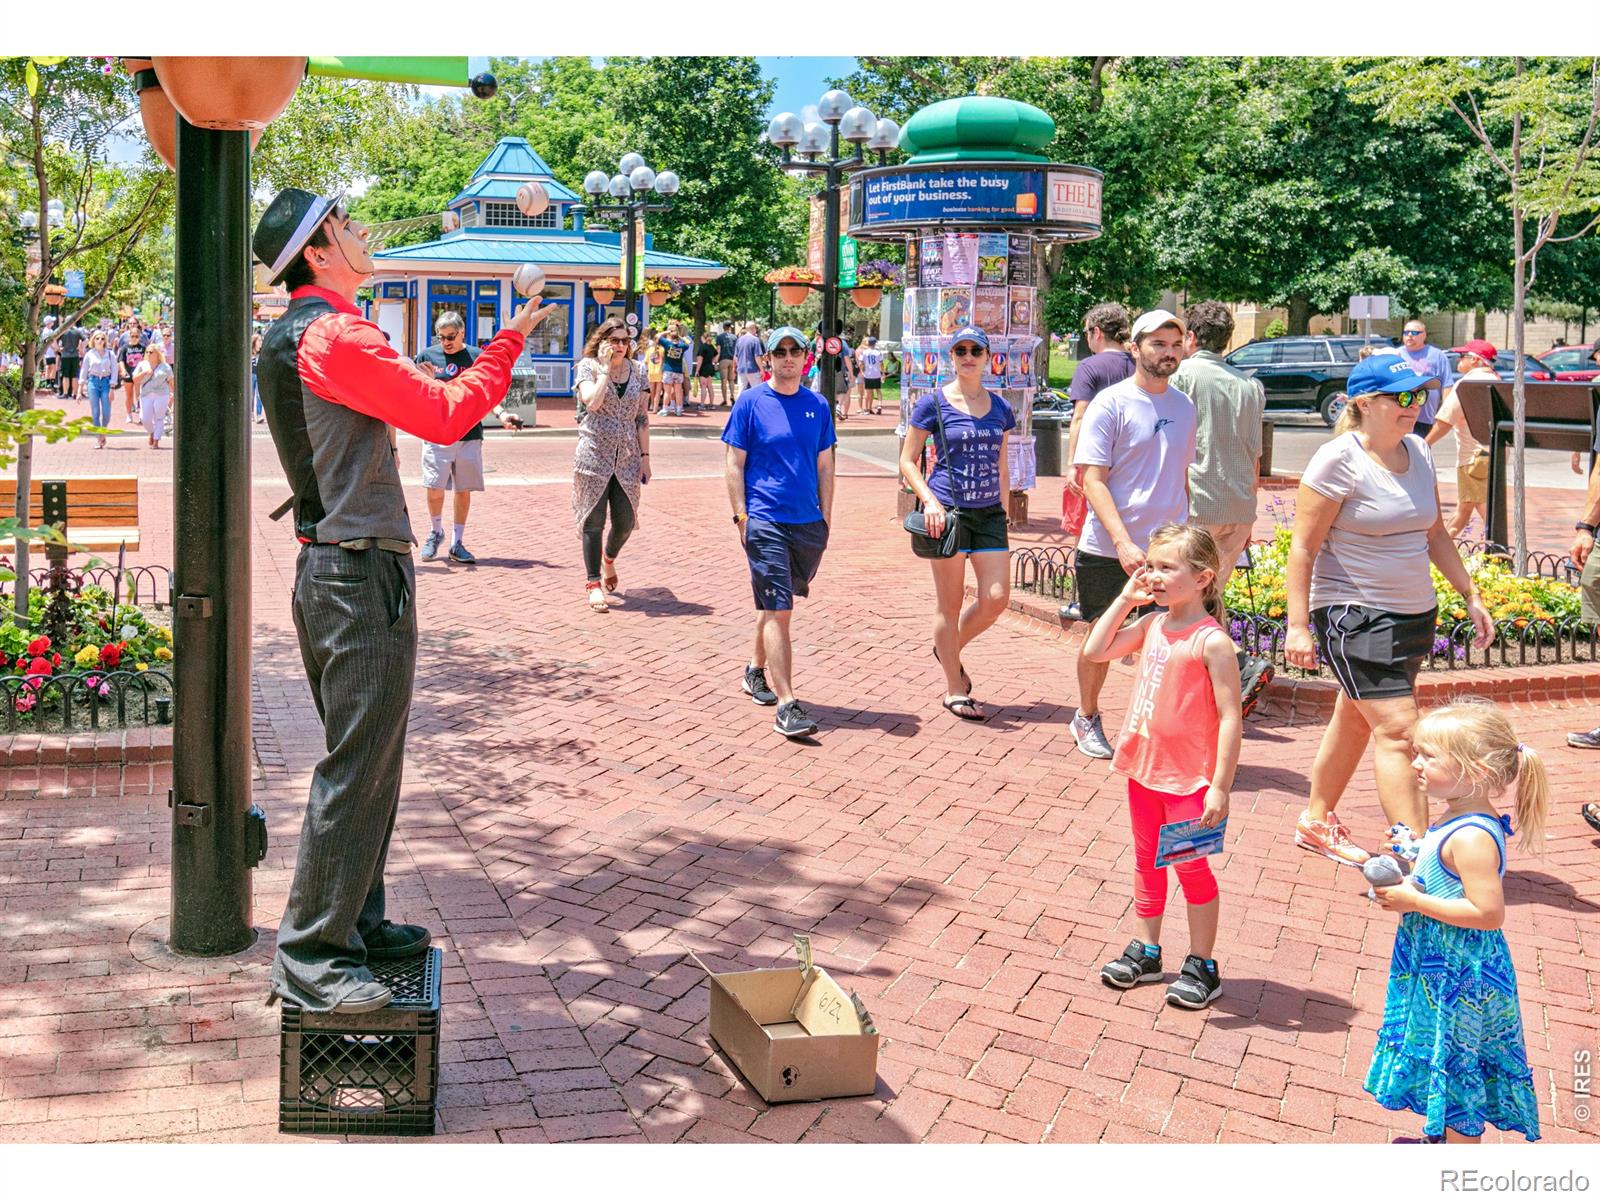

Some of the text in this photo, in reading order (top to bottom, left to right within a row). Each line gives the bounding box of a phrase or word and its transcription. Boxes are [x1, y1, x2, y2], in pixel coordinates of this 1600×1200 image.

[868, 176, 1009, 193] Let FirstBank take the busy
[1053, 183, 1086, 203] THE
[868, 189, 972, 206] out of your business.
[867, 354, 876, 365] 18
